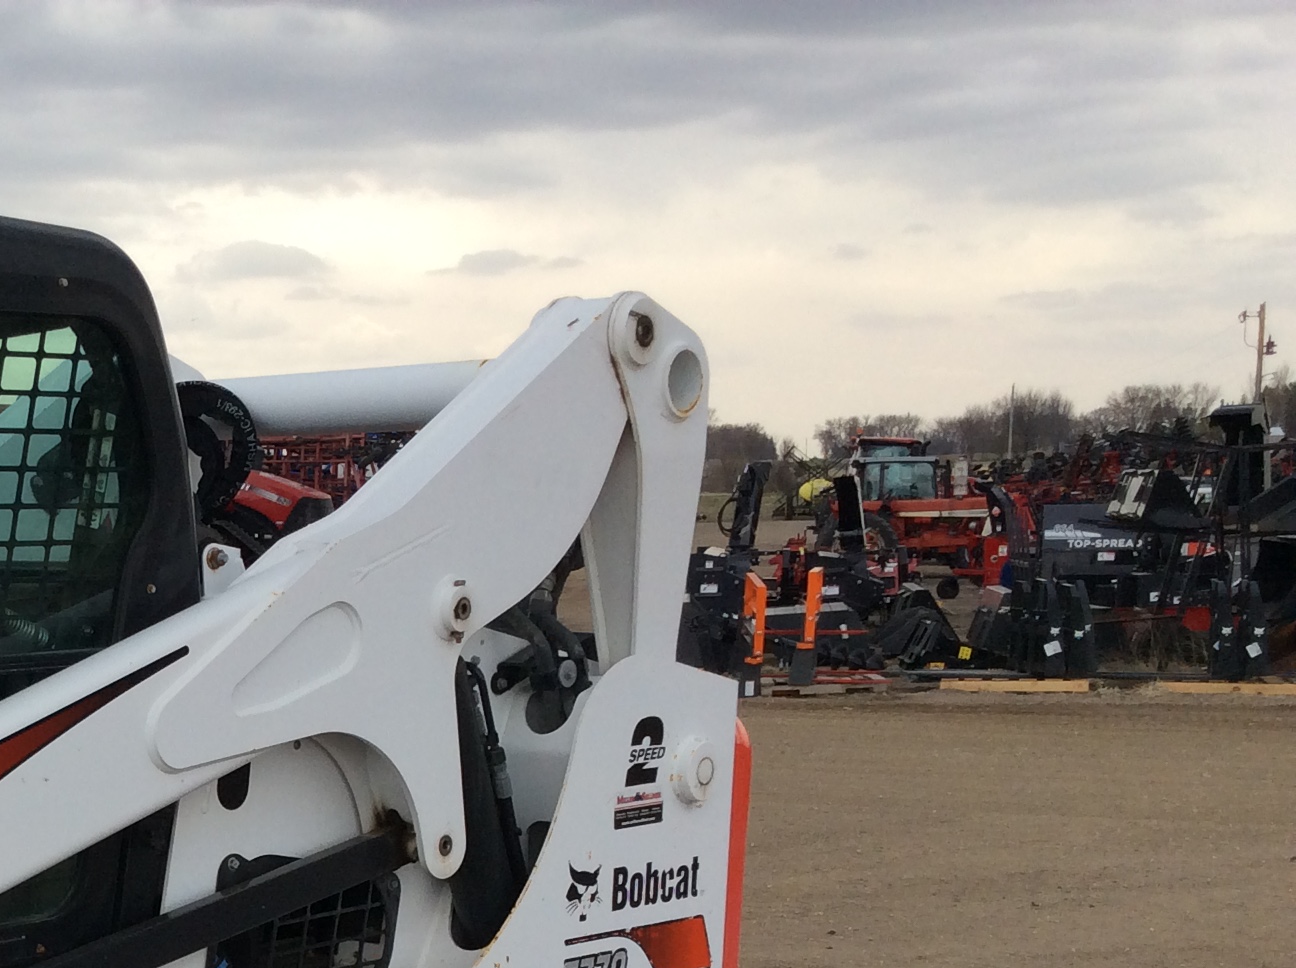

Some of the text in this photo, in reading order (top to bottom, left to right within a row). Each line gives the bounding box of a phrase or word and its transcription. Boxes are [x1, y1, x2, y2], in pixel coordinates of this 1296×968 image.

[244, 433, 256, 471] MSHA
[625, 716, 664, 787] 2
[629, 746, 666, 764] SPEED
[612, 856, 699, 911] Bobcat
